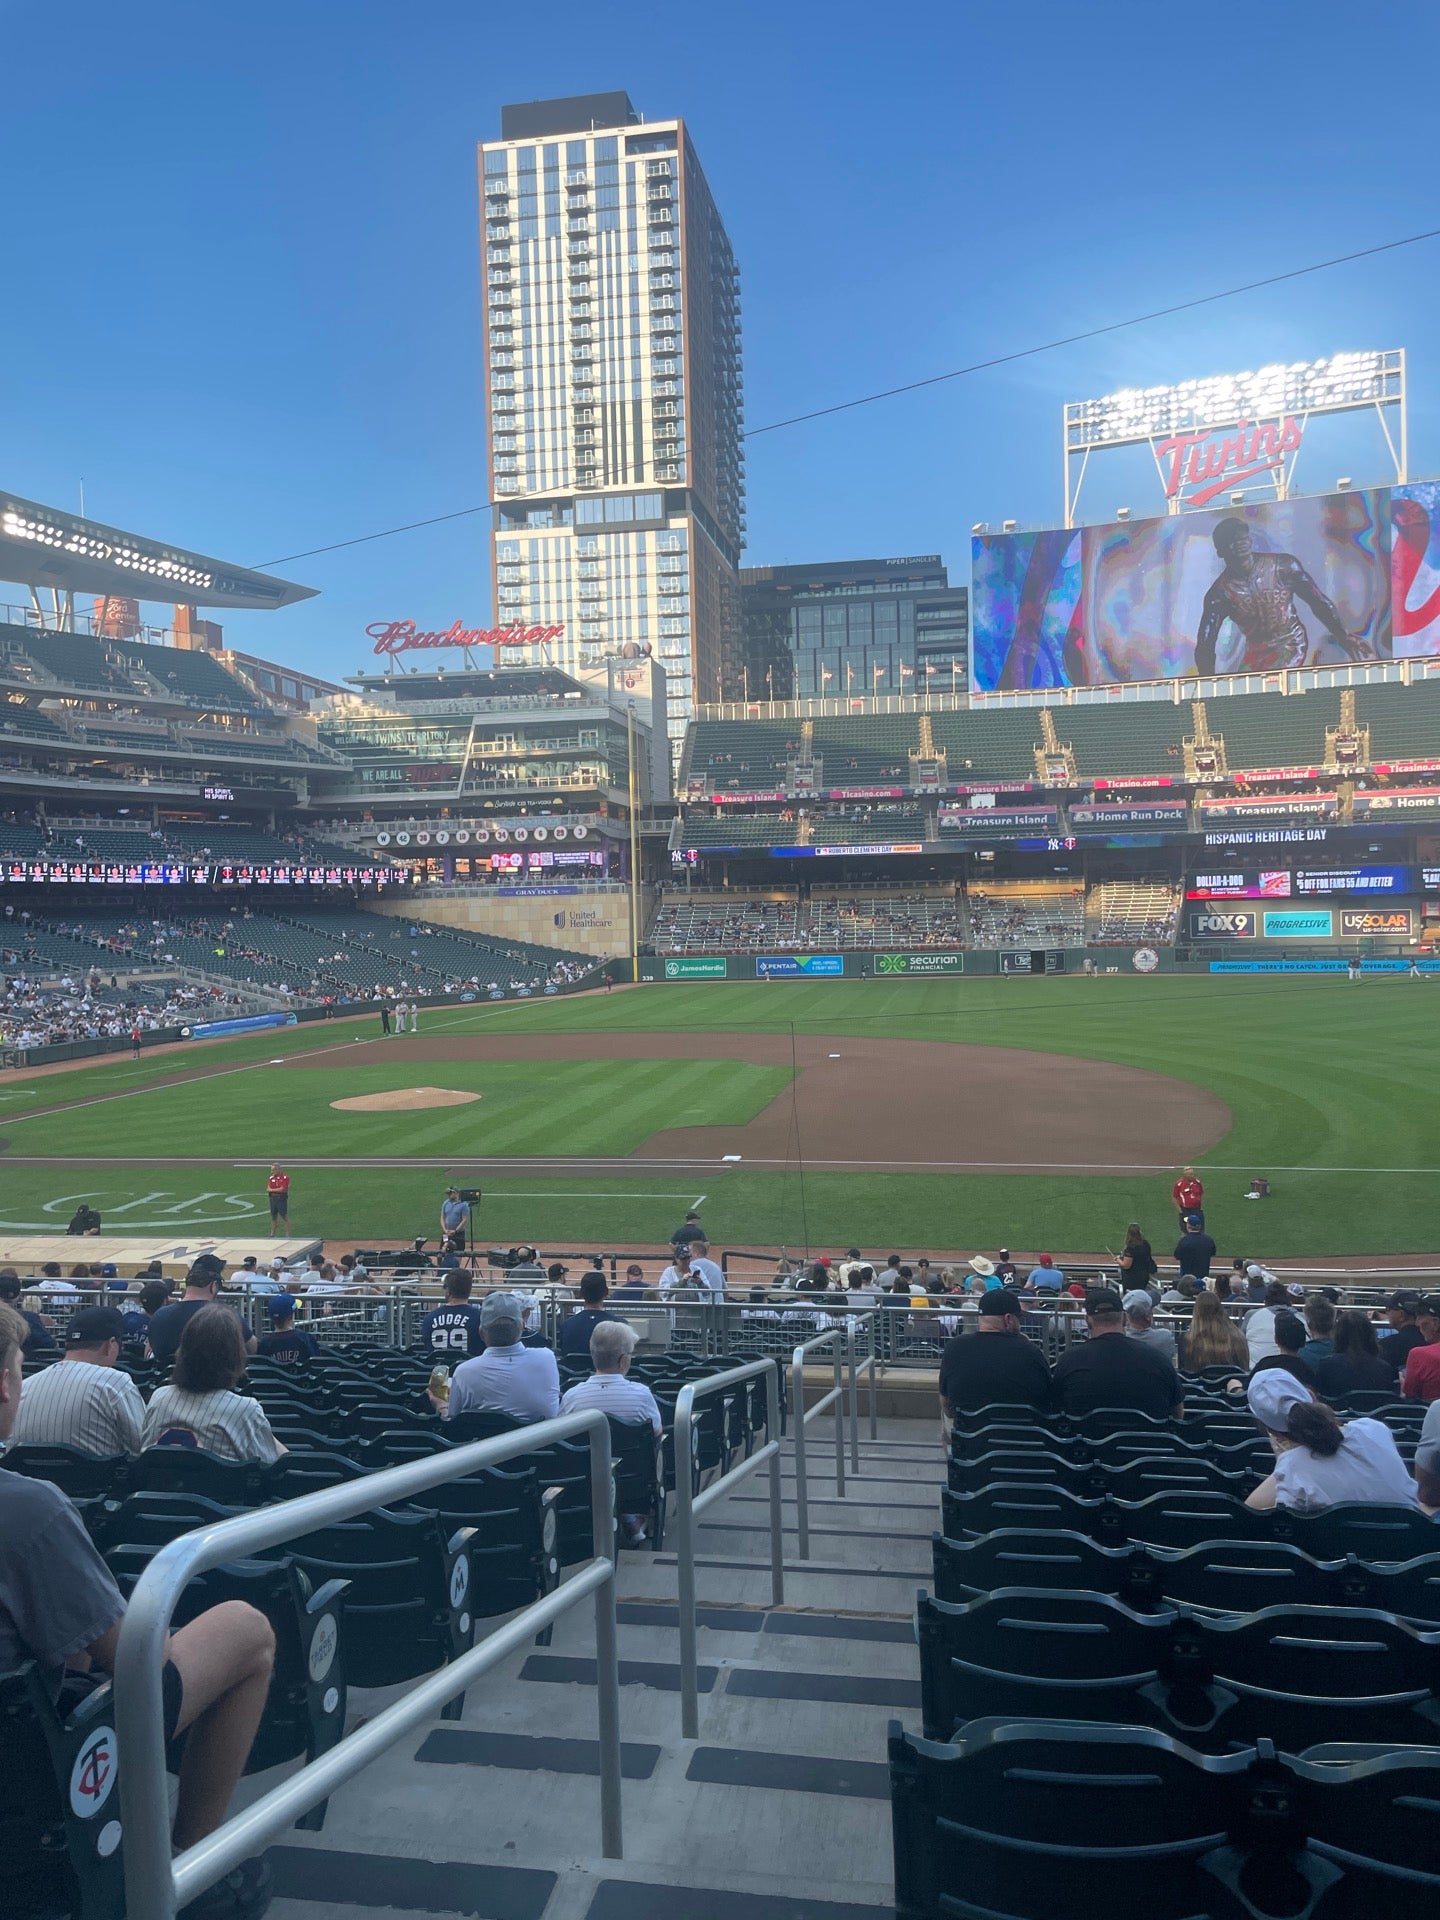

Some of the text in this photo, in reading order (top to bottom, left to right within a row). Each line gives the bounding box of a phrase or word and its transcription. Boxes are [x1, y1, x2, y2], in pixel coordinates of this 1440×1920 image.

[1155, 416, 1303, 499] Twins
[886, 556, 937, 566] PIPER SANDLER
[366, 618, 565, 655] Budweiser
[374, 732, 402, 744] TWINS
[362, 770, 374, 781] WE
[375, 770, 389, 781] ARE
[389, 769, 402, 780] ALL
[1243, 771, 1310, 781] Treasure Island
[965, 784, 1025, 793] Treasure Island
[755, 793, 777, 801] Island
[1397, 798, 1435, 808] Home
[1234, 803, 1326, 815] Treasure Island
[965, 814, 1048, 826] Treasure Island
[1096, 810, 1183, 822] Home Run Deck
[1205, 829, 1327, 845] HISPANIC HERITAGE DAY
[1196, 874, 1244, 887] DOLLAR-A-DOG
[1296, 876, 1394, 890] $5 OFF FOR FANS 55 AND BETTER
[569, 911, 596, 920] United
[570, 919, 612, 928] Healthcare
[1198, 915, 1248, 931] FOX 9
[1266, 919, 1329, 929] PROGRESSIVE
[768, 962, 798, 970] PENTAIR
[910, 955, 958, 965] securian
[680, 964, 724, 972] JamesHardie
[42, 1192, 269, 1214] CHS
[1003, 1271, 1014, 1284] 25
[431, 1313, 470, 1329] JUDGE
[431, 1328, 468, 1352] 99
